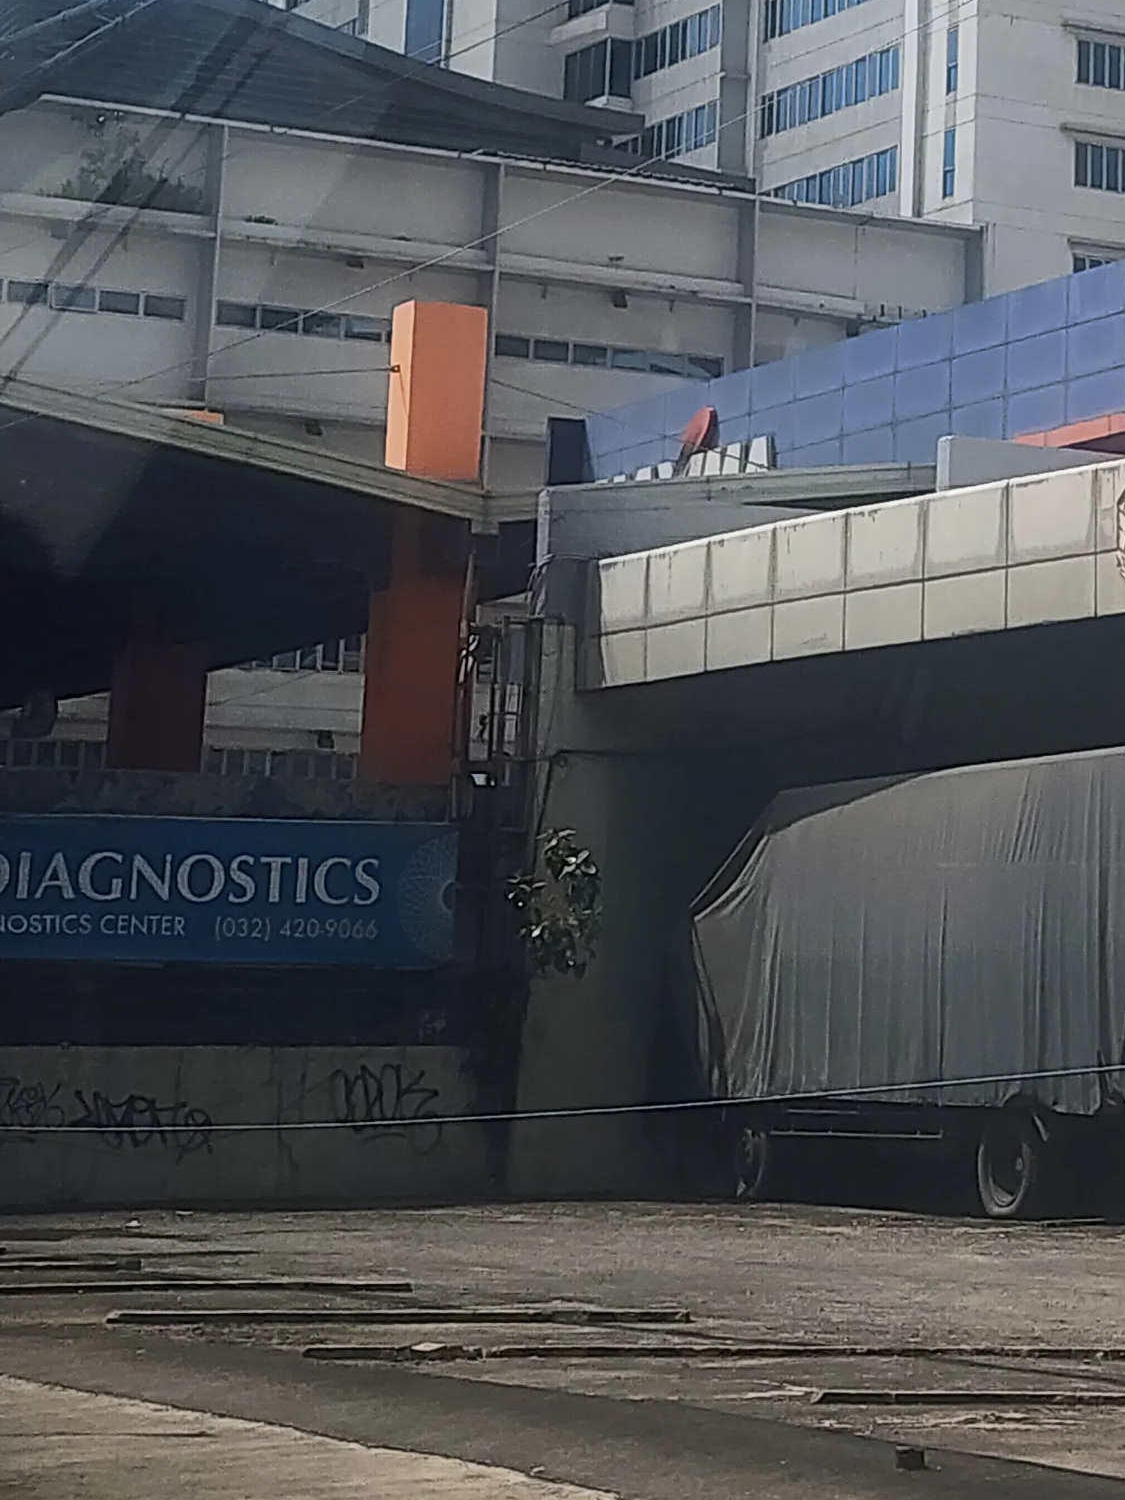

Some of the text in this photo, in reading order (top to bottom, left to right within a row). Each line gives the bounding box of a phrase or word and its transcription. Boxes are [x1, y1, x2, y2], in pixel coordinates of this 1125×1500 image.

[0, 850, 381, 905] IAGNOSTICS
[100, 914, 186, 937] CENTER
[214, 916, 271, 942] (032)
[279, 917, 378, 940] 420-9066
